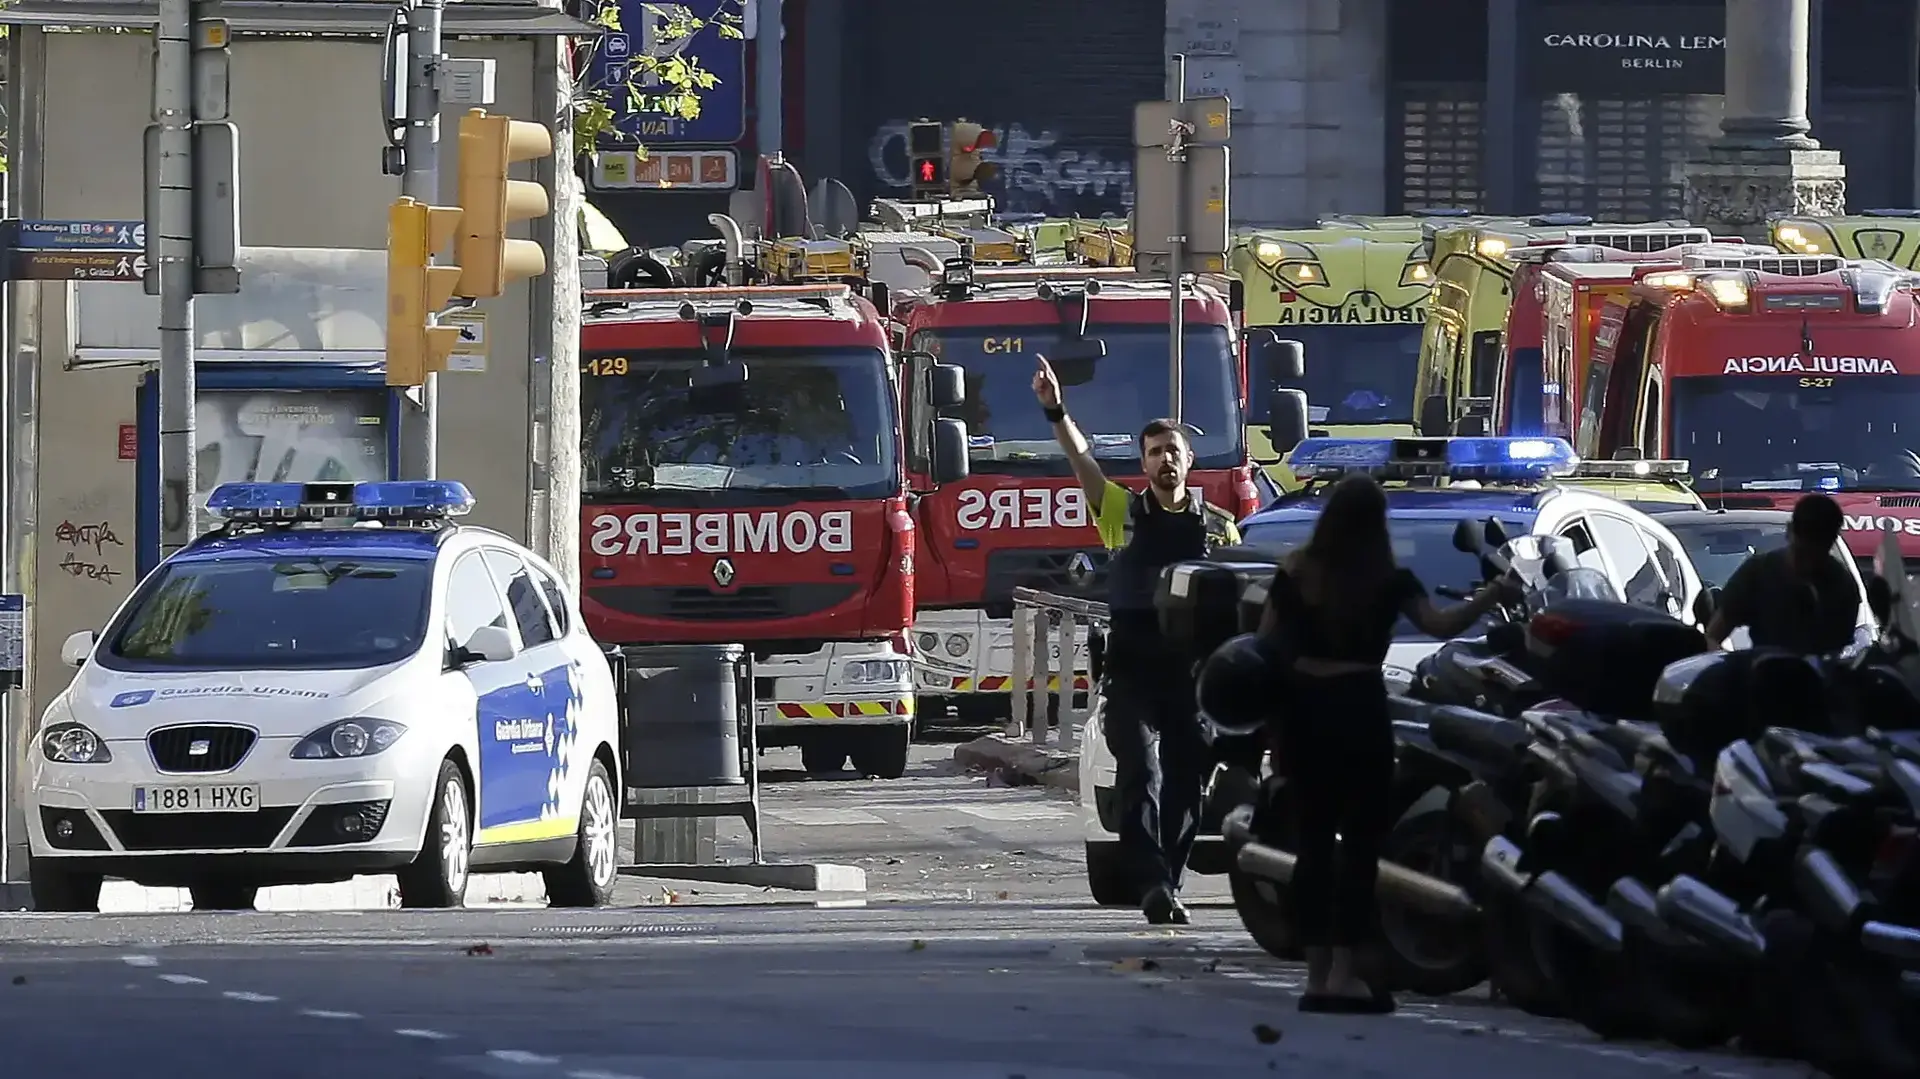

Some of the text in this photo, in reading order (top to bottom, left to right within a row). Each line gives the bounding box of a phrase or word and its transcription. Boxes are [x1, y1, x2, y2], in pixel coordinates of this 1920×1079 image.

[1544, 34, 1727, 49] CAROLINA LEM
[1622, 58, 1683, 68] BERLIN
[983, 337, 1023, 354] C-11
[580, 357, 628, 376] -129
[1799, 377, 1834, 388] S-27
[252, 686, 330, 699] Urbana
[152, 786, 253, 810] 1881 HXG
